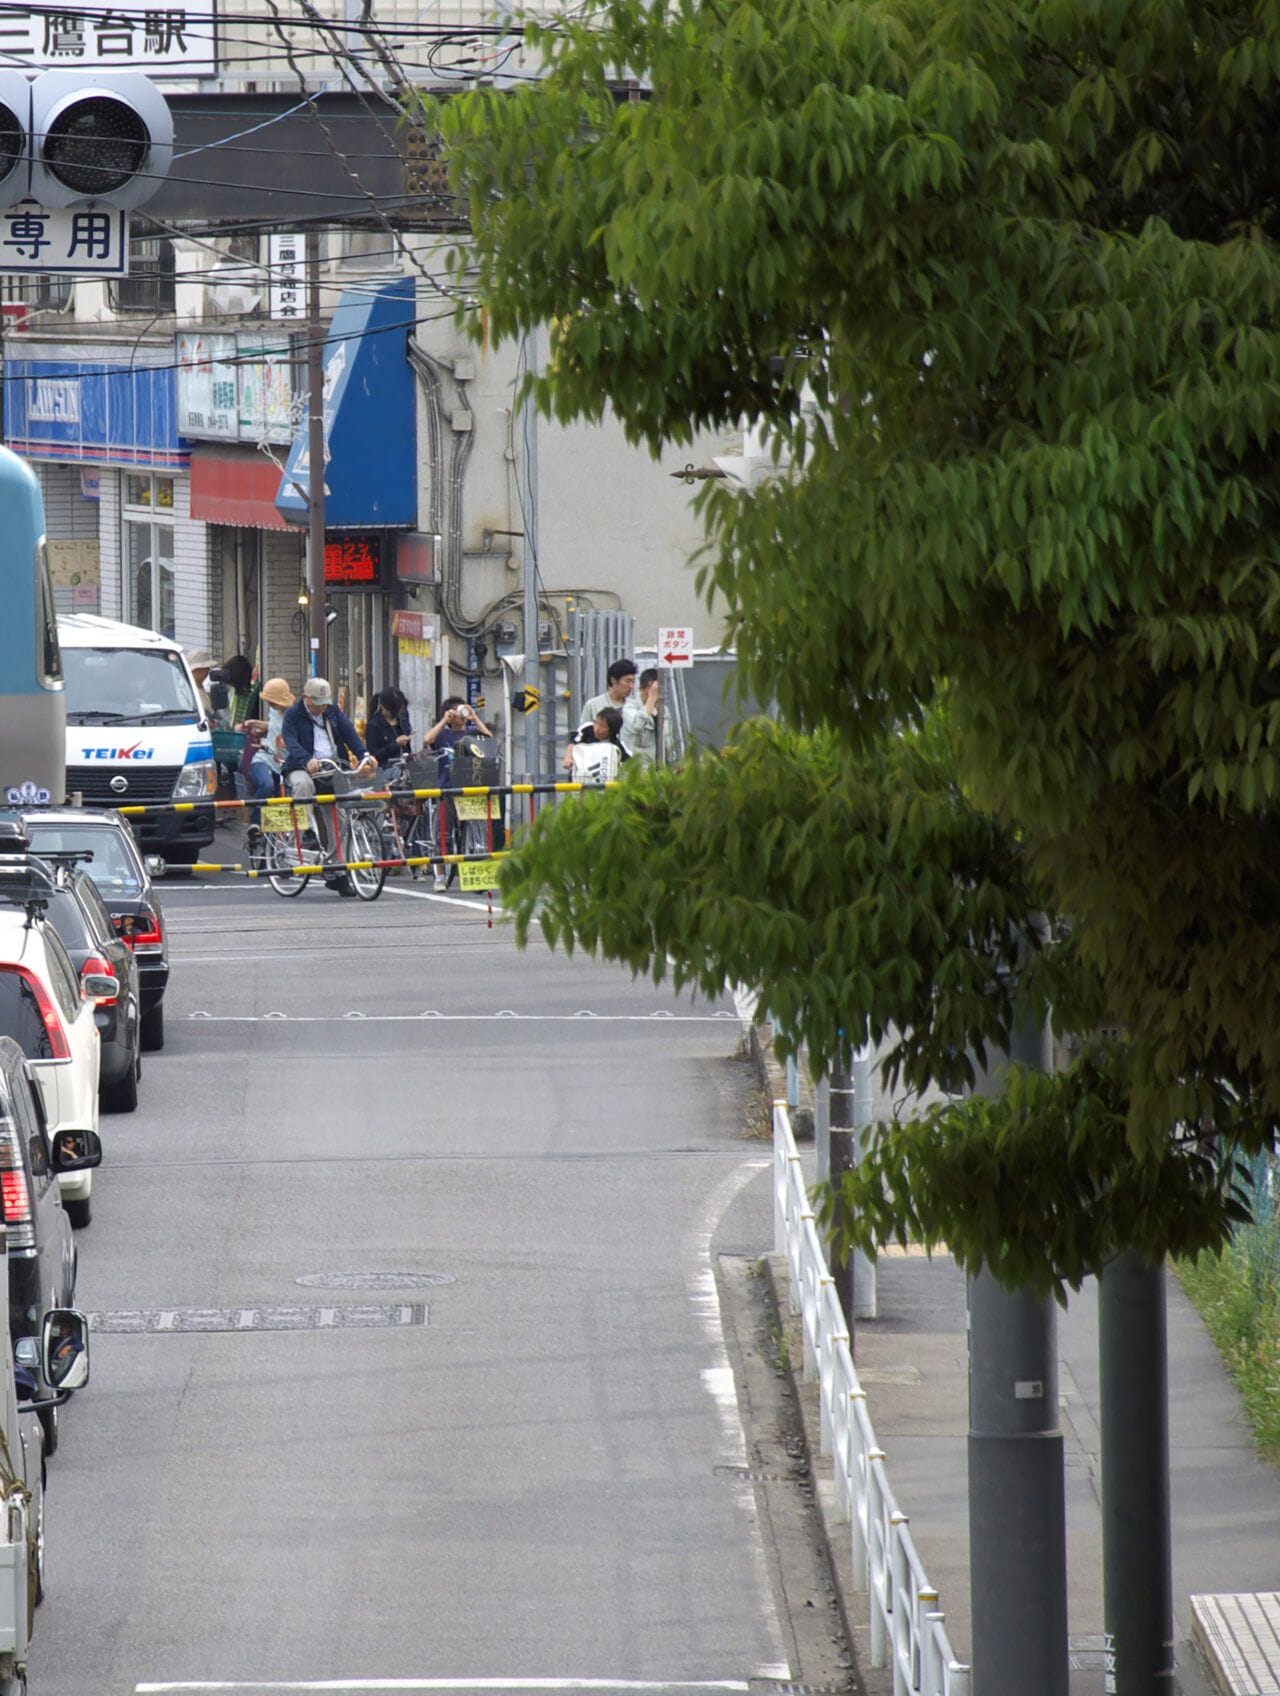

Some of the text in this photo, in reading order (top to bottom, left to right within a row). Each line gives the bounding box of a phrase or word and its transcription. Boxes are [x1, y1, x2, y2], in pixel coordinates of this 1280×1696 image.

[278, 235, 298, 317] 三鷹台商店会
[665, 630, 686, 639] 非常
[663, 640, 689, 649] ボタン
[461, 866, 491, 876] しばらく
